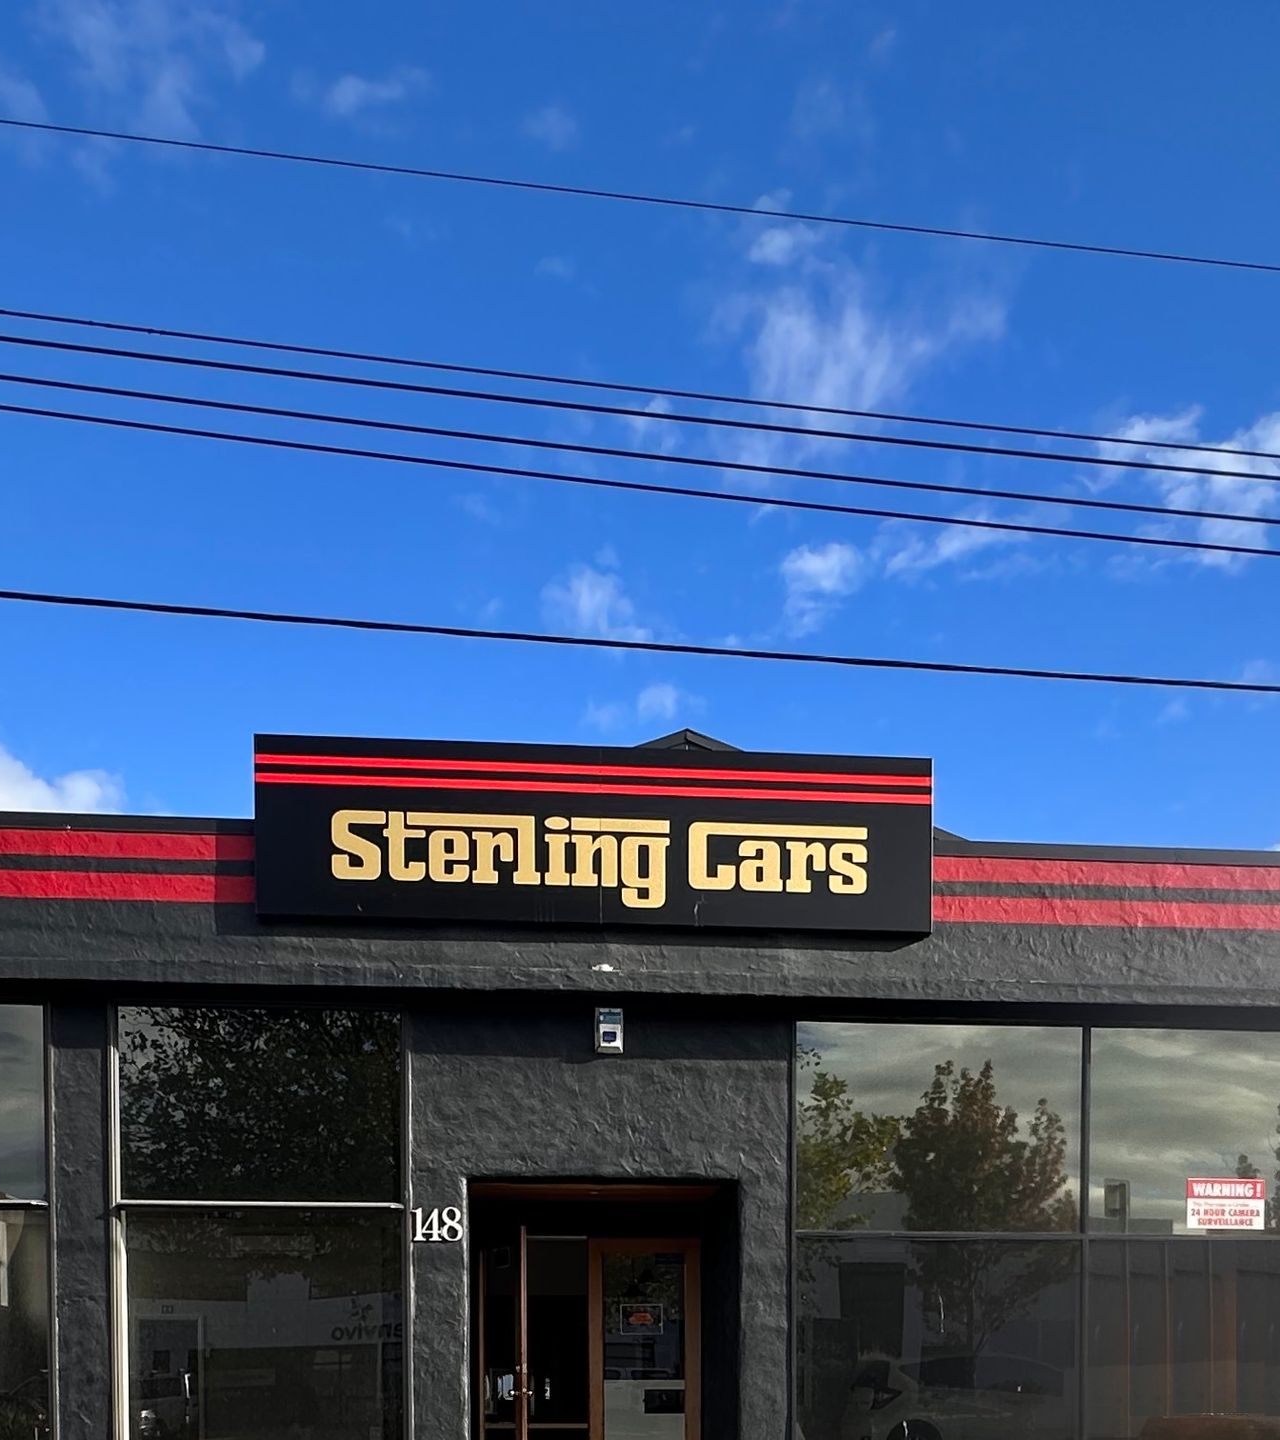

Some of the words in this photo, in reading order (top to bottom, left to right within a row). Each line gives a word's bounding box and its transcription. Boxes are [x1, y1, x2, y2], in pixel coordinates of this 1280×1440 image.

[331, 808, 670, 909] Sterling
[688, 821, 868, 895] Cars
[1192, 1182, 1254, 1198] WARNING
[410, 1206, 464, 1242] 148
[1190, 1208, 1201, 1217] 24
[1203, 1208, 1226, 1217] HOUR
[1228, 1208, 1261, 1218] CAMERA
